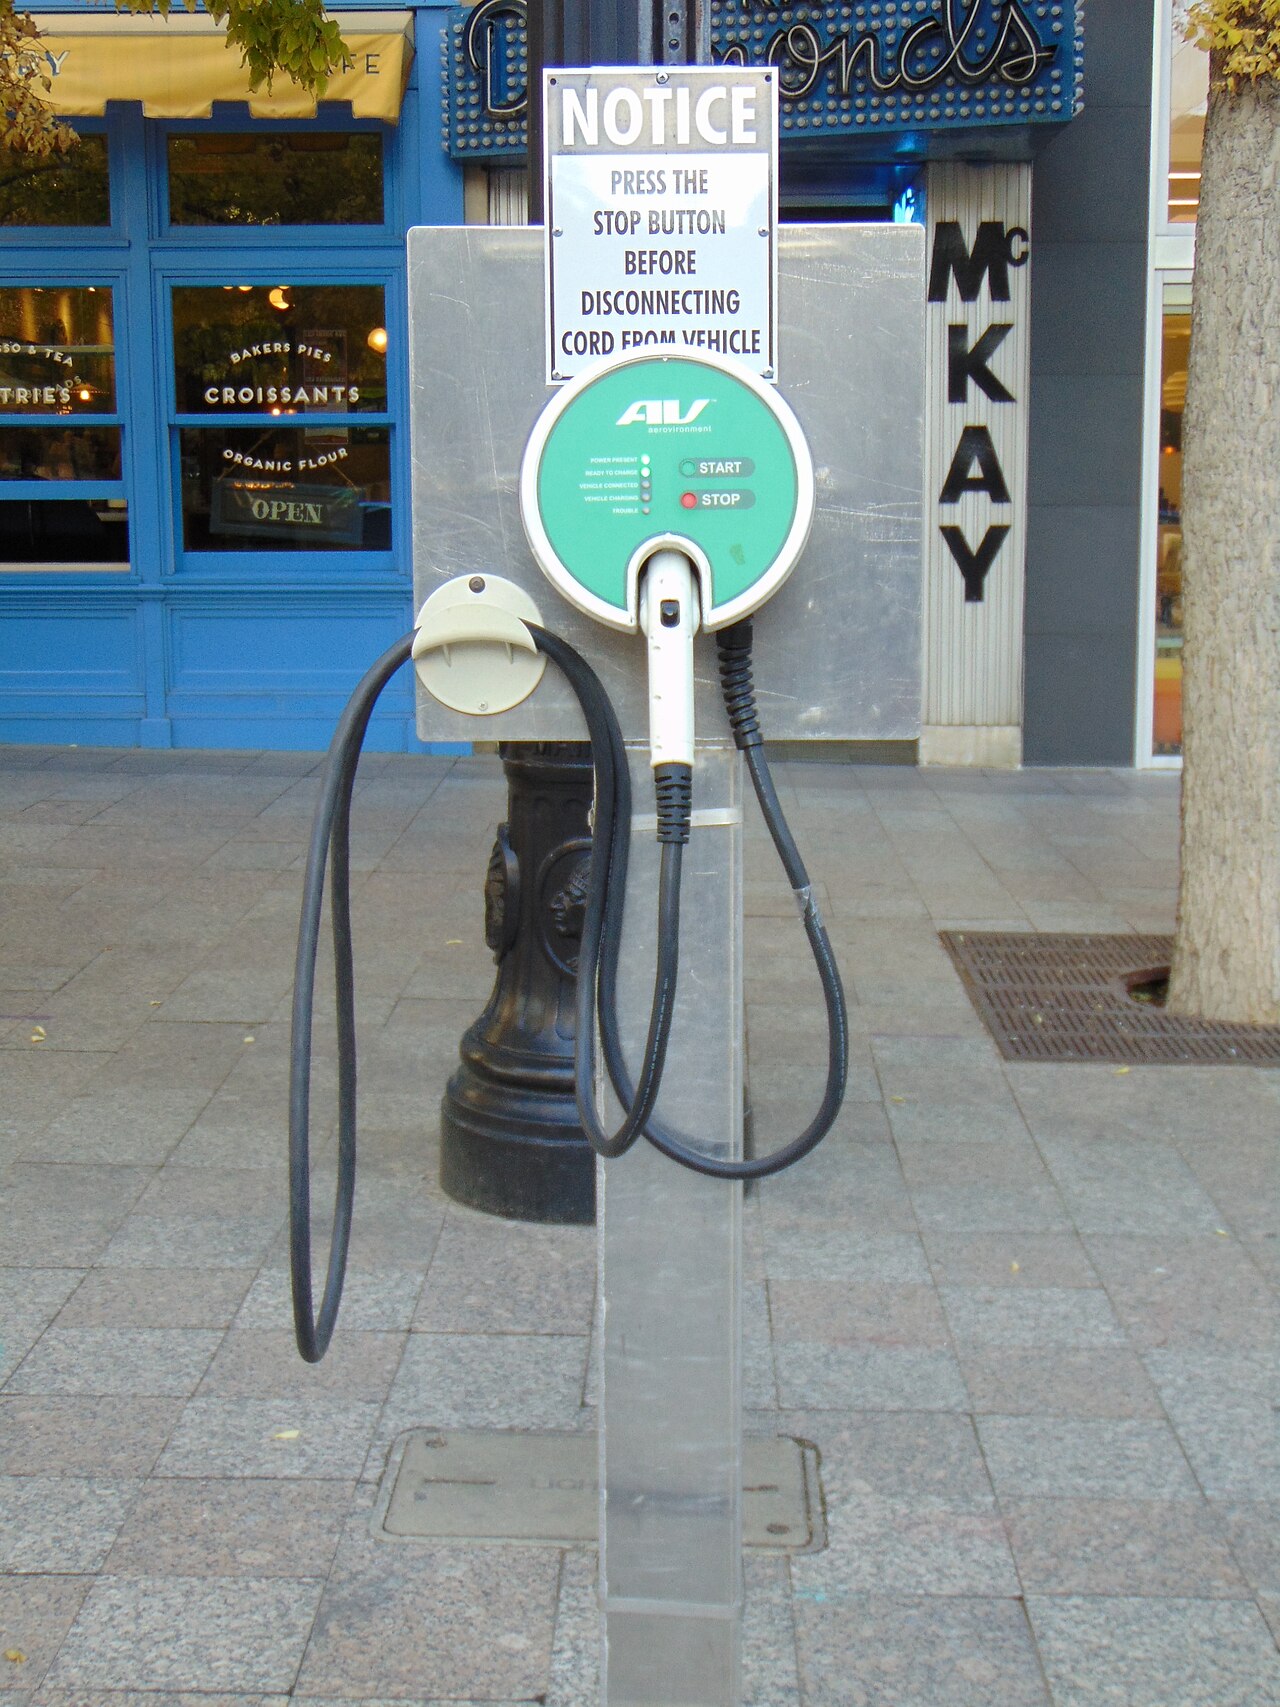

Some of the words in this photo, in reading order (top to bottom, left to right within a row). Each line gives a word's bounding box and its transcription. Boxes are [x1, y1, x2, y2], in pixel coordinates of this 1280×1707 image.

[562, 86, 757, 146] NOTICE
[611, 170, 667, 194] PRESS
[673, 169, 708, 194] THE
[593, 210, 641, 235] STOP
[648, 210, 726, 235] BUTTON
[625, 250, 696, 275] BEFORE
[581, 290, 740, 316] DISCONNECTING
[230, 342, 291, 364] BAKERS
[297, 344, 332, 363] PIES
[562, 331, 615, 356] CORD
[682, 329, 761, 354] VEHICLE
[45, 348, 73, 367] TEA
[204, 386, 360, 404] CROISSANTS
[222, 449, 292, 471] ORGANIC
[299, 448, 348, 471] FLOUR
[699, 461, 742, 474] START
[251, 499, 324, 524] OPEN
[702, 493, 741, 505] STOP
